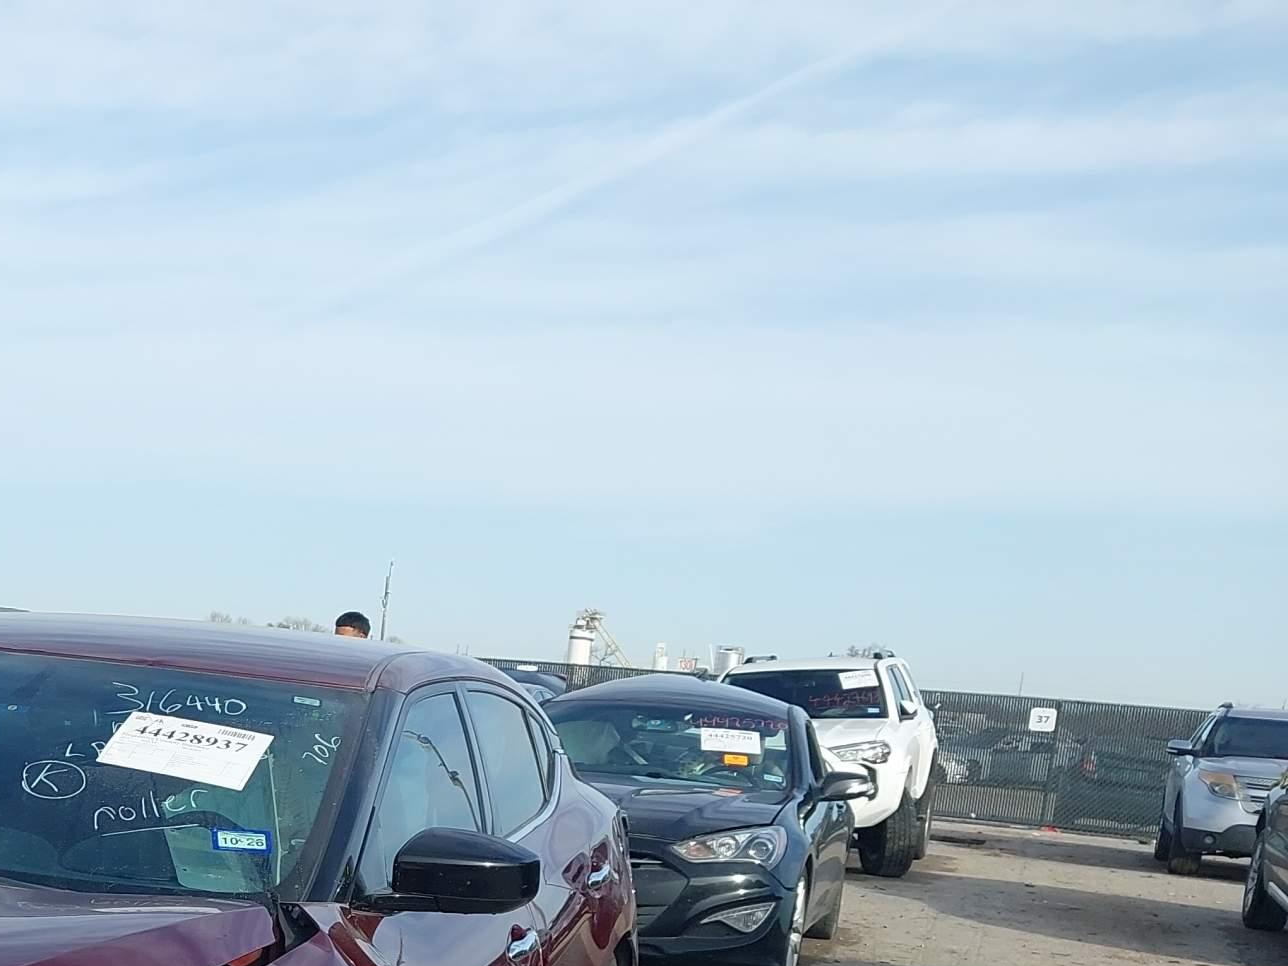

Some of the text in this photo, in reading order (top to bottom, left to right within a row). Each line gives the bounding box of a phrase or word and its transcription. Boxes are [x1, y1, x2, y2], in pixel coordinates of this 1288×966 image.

[105, 682, 247, 715] 316440
[1035, 714, 1050, 723] 37
[135, 724, 249, 753] 44428937
